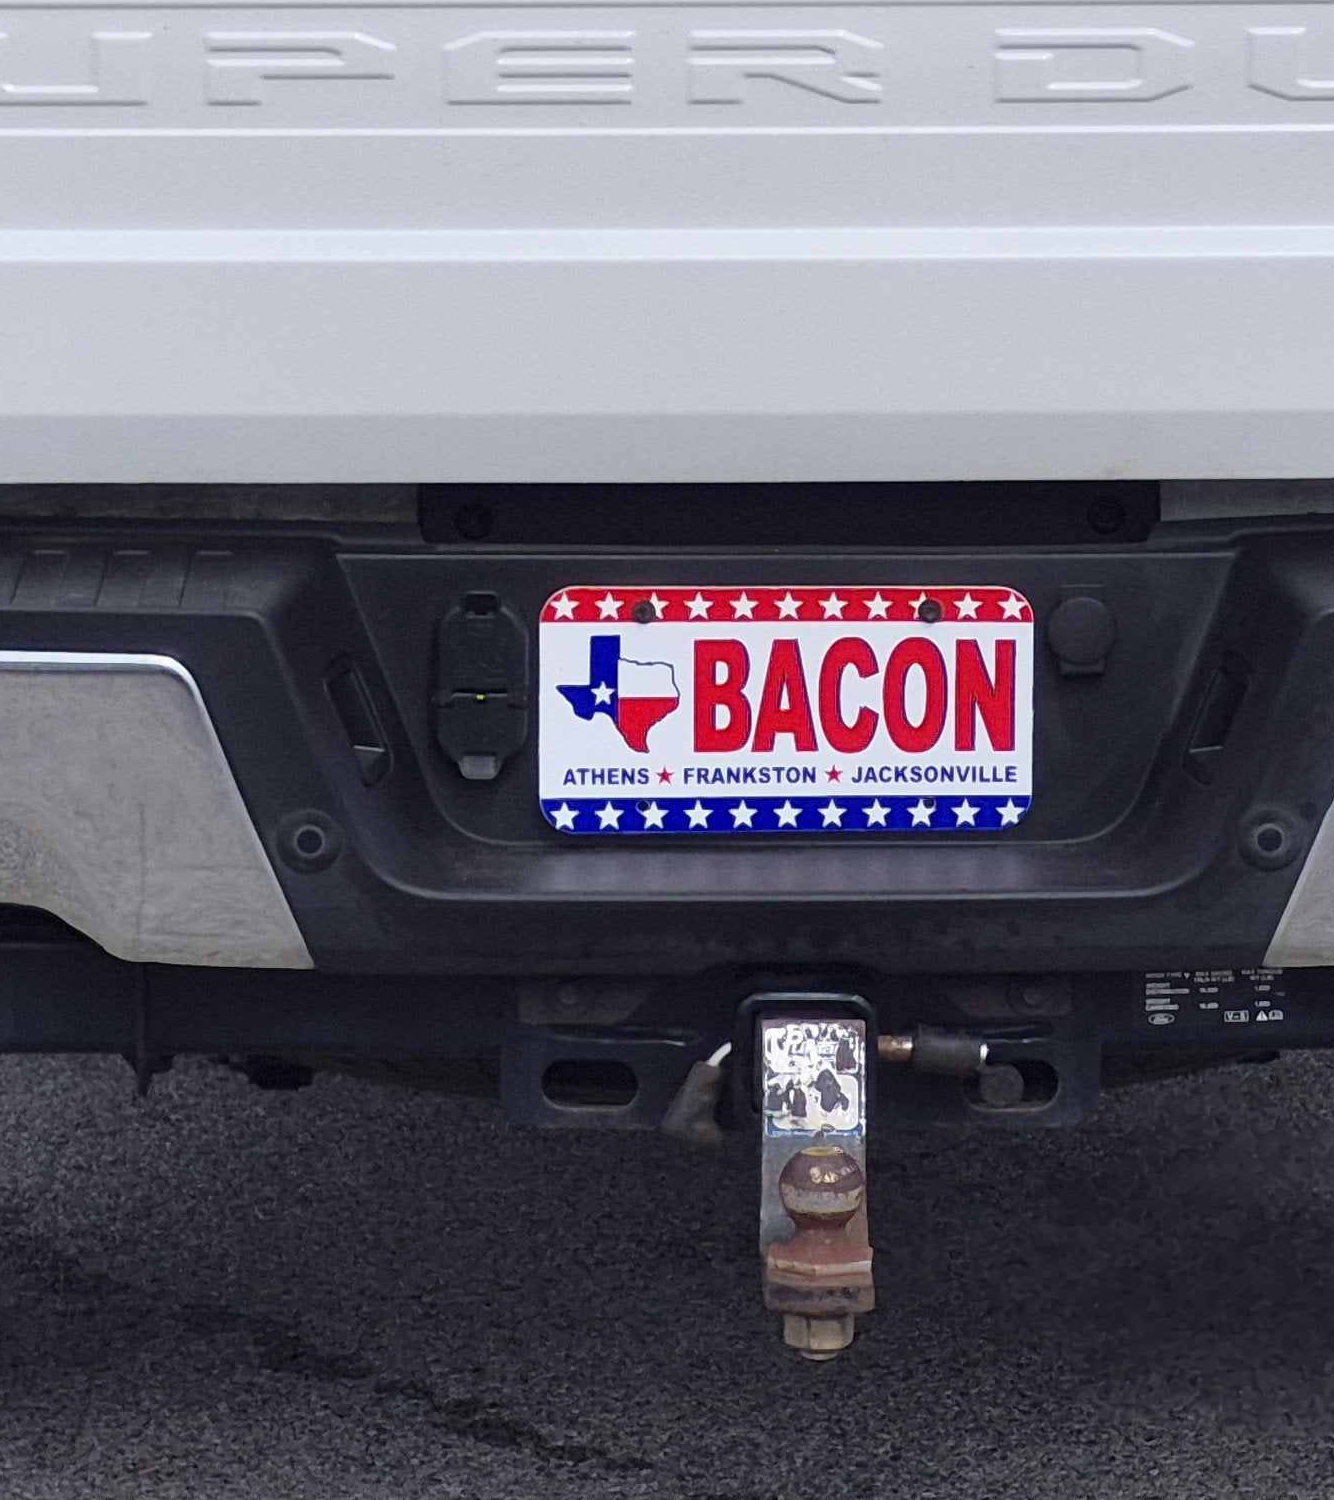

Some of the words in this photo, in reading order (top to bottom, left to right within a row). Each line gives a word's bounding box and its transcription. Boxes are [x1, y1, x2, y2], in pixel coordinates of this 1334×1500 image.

[692, 636, 1018, 755] BACON
[562, 766, 651, 786] ATHENS
[682, 765, 818, 785] FRANKSTON
[850, 764, 1018, 784] JACKSONVILLE
